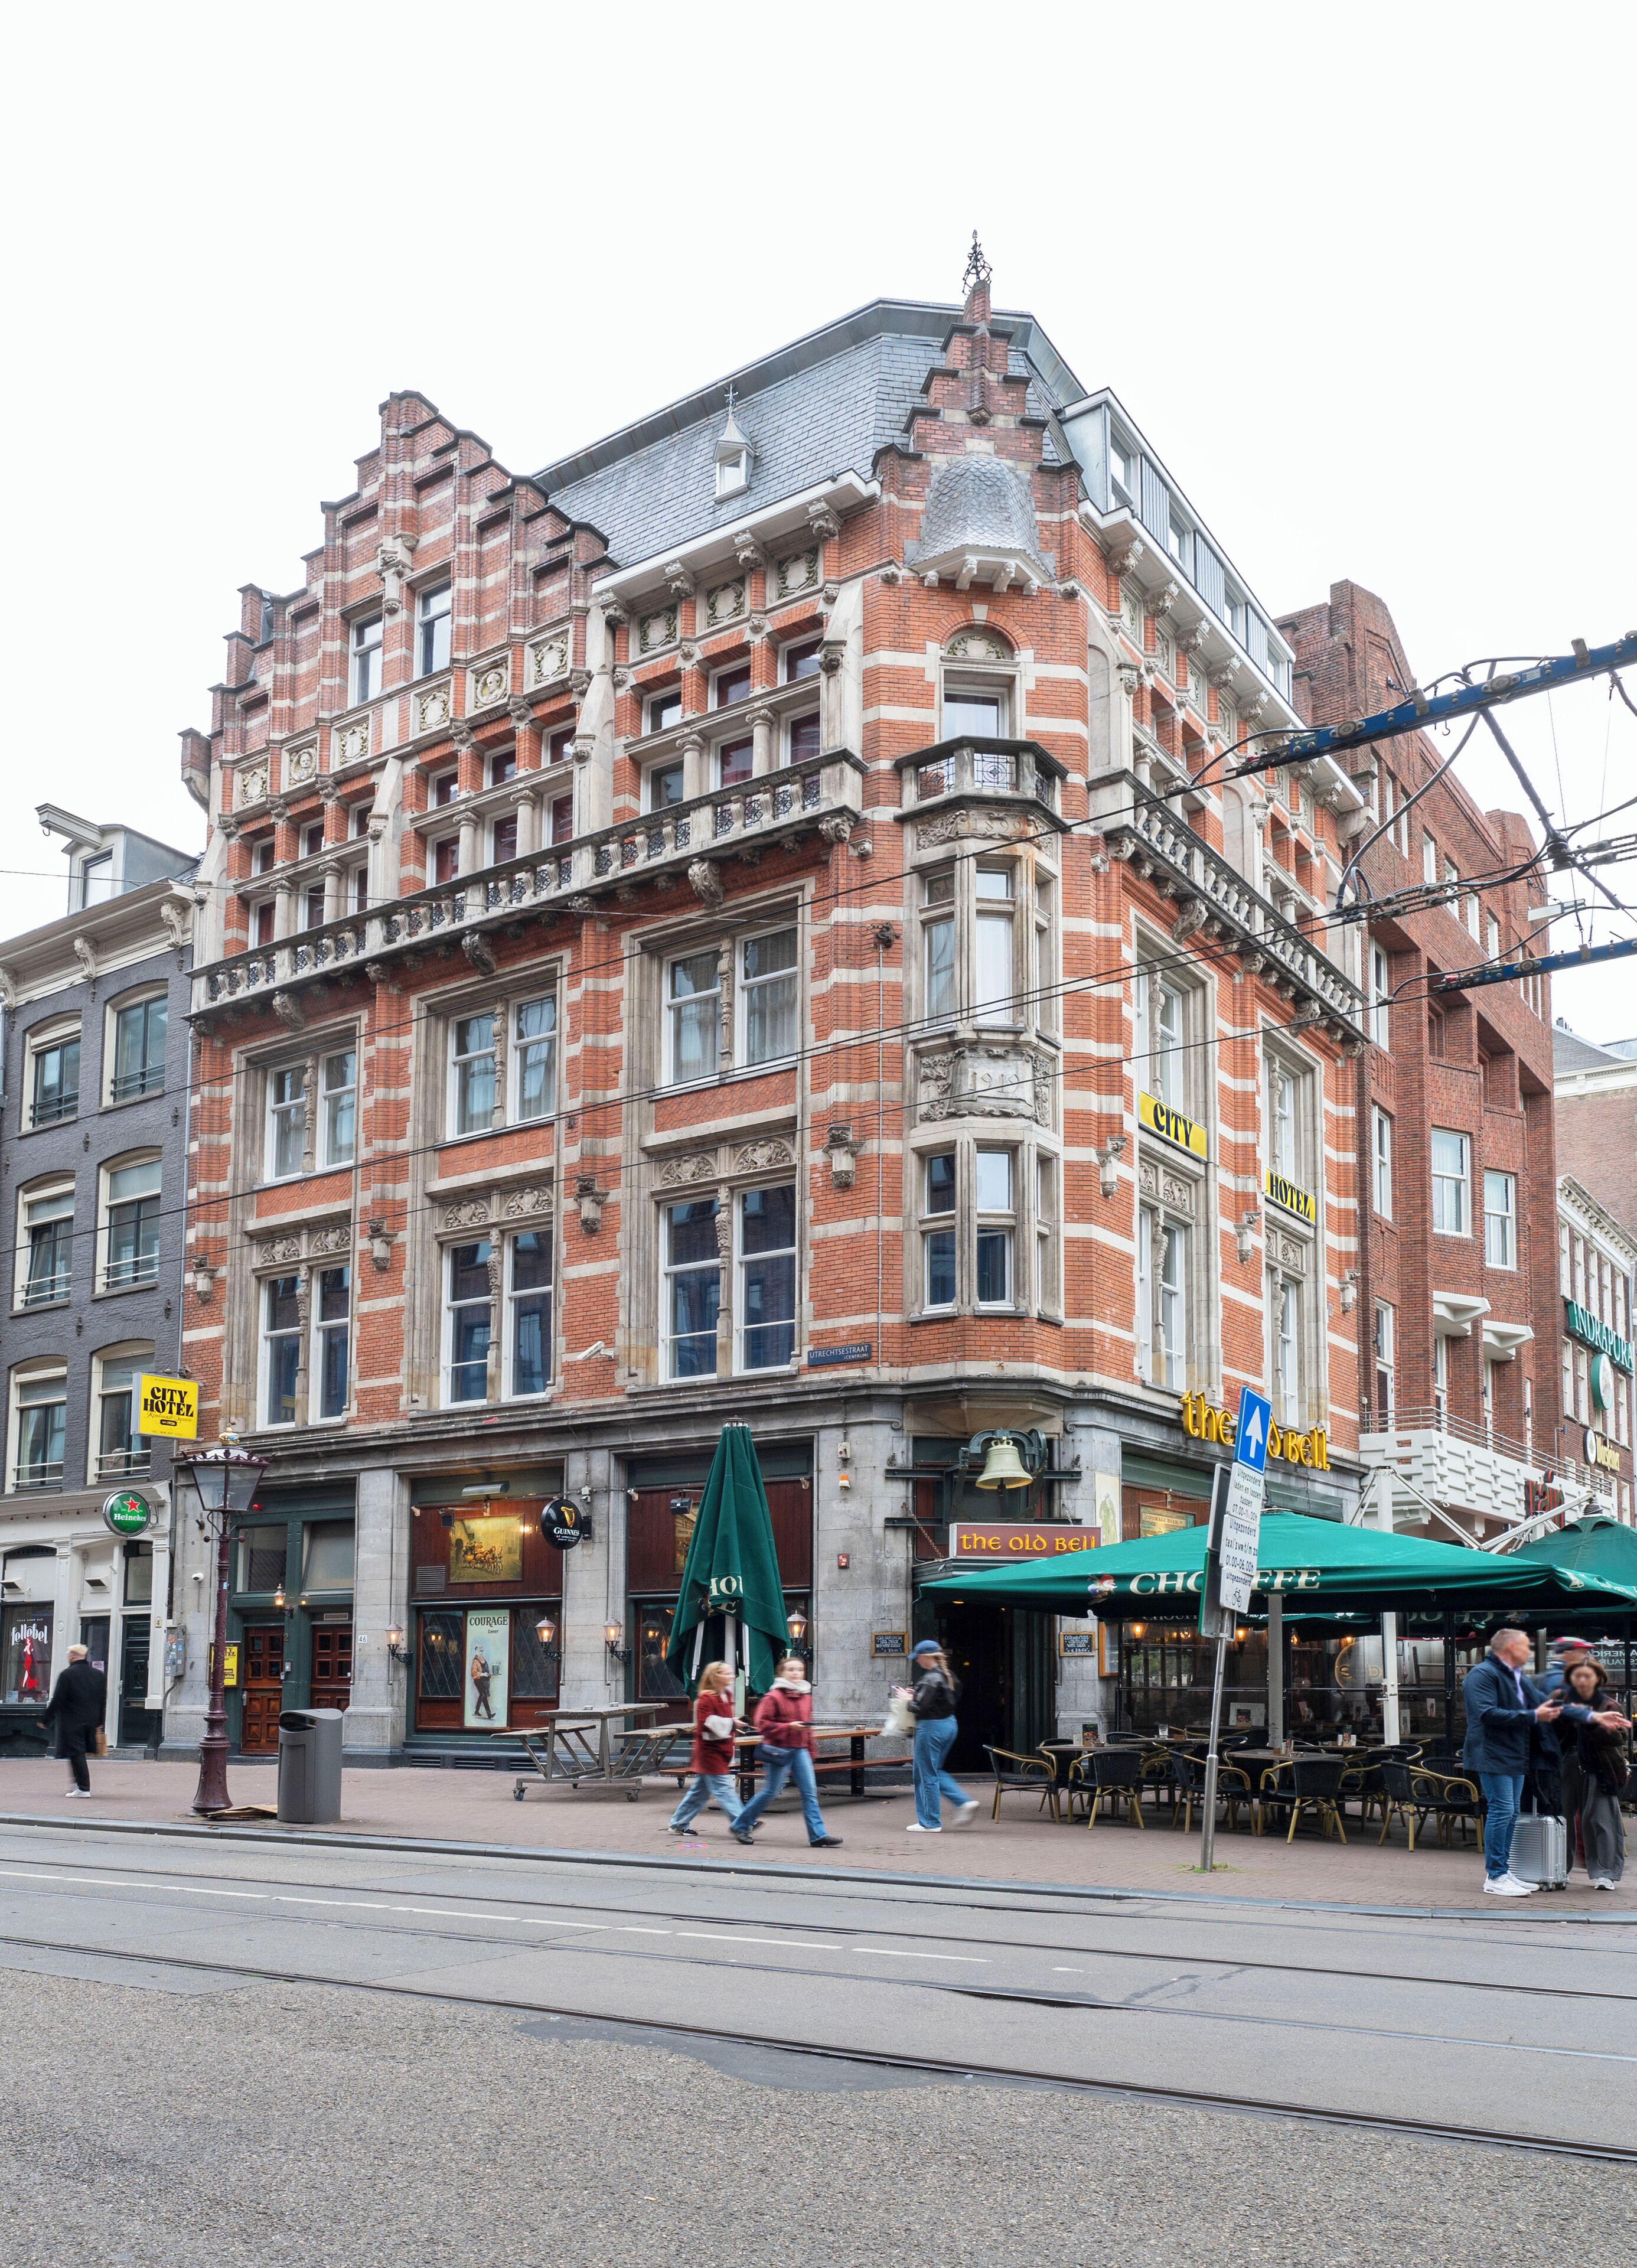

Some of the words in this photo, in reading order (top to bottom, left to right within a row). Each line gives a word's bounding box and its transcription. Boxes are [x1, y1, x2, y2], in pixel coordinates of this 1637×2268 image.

[1153, 1103, 1193, 1148] CITY
[1270, 1172, 1310, 1220] HOTEL
[1573, 1299, 1634, 1371] INDRAPURA
[810, 1345, 869, 1358] UTRECHTSESTRAAT
[151, 1386, 188, 1403] CITY
[144, 1398, 194, 1417] HOTEL
[113, 1513, 147, 1522] Heineken
[553, 1527, 580, 1536] GUINNESS
[1129, 1569, 1320, 1595] CHOFFE
[469, 1616, 508, 1627] COURAGE
